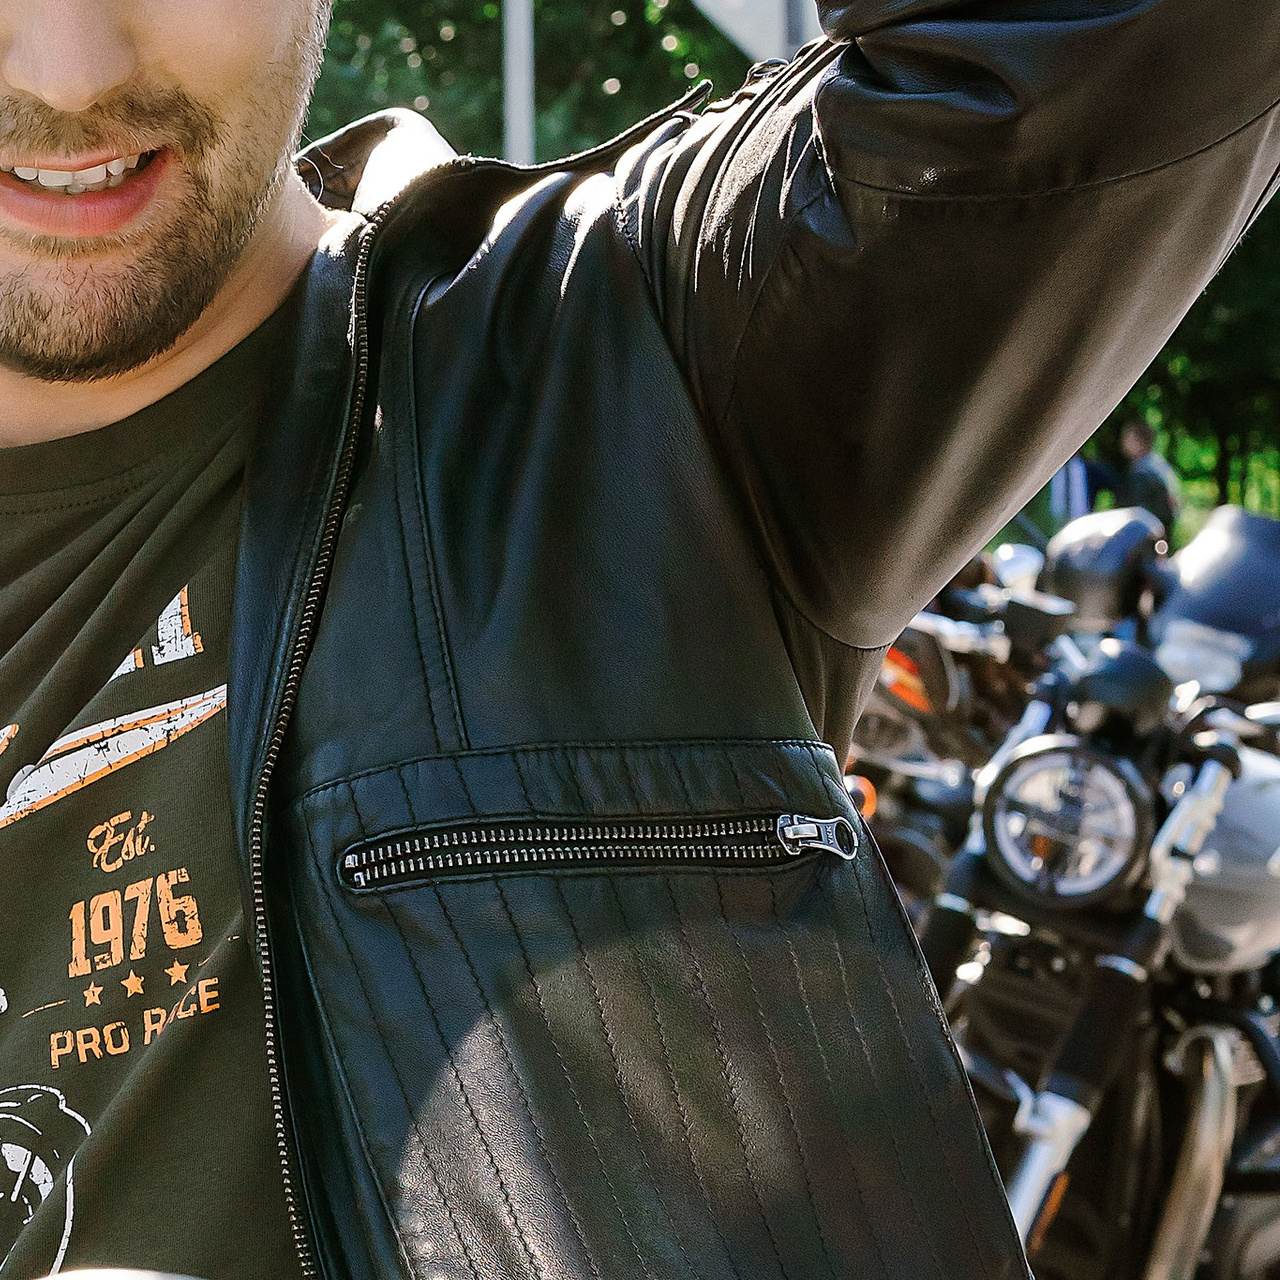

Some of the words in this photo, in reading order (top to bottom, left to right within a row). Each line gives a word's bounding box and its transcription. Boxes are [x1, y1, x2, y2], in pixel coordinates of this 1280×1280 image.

[86, 810, 156, 873] Est.
[68, 867, 203, 978] 1976
[49, 1021, 130, 1070] PRO
[143, 977, 221, 1046] RCE
